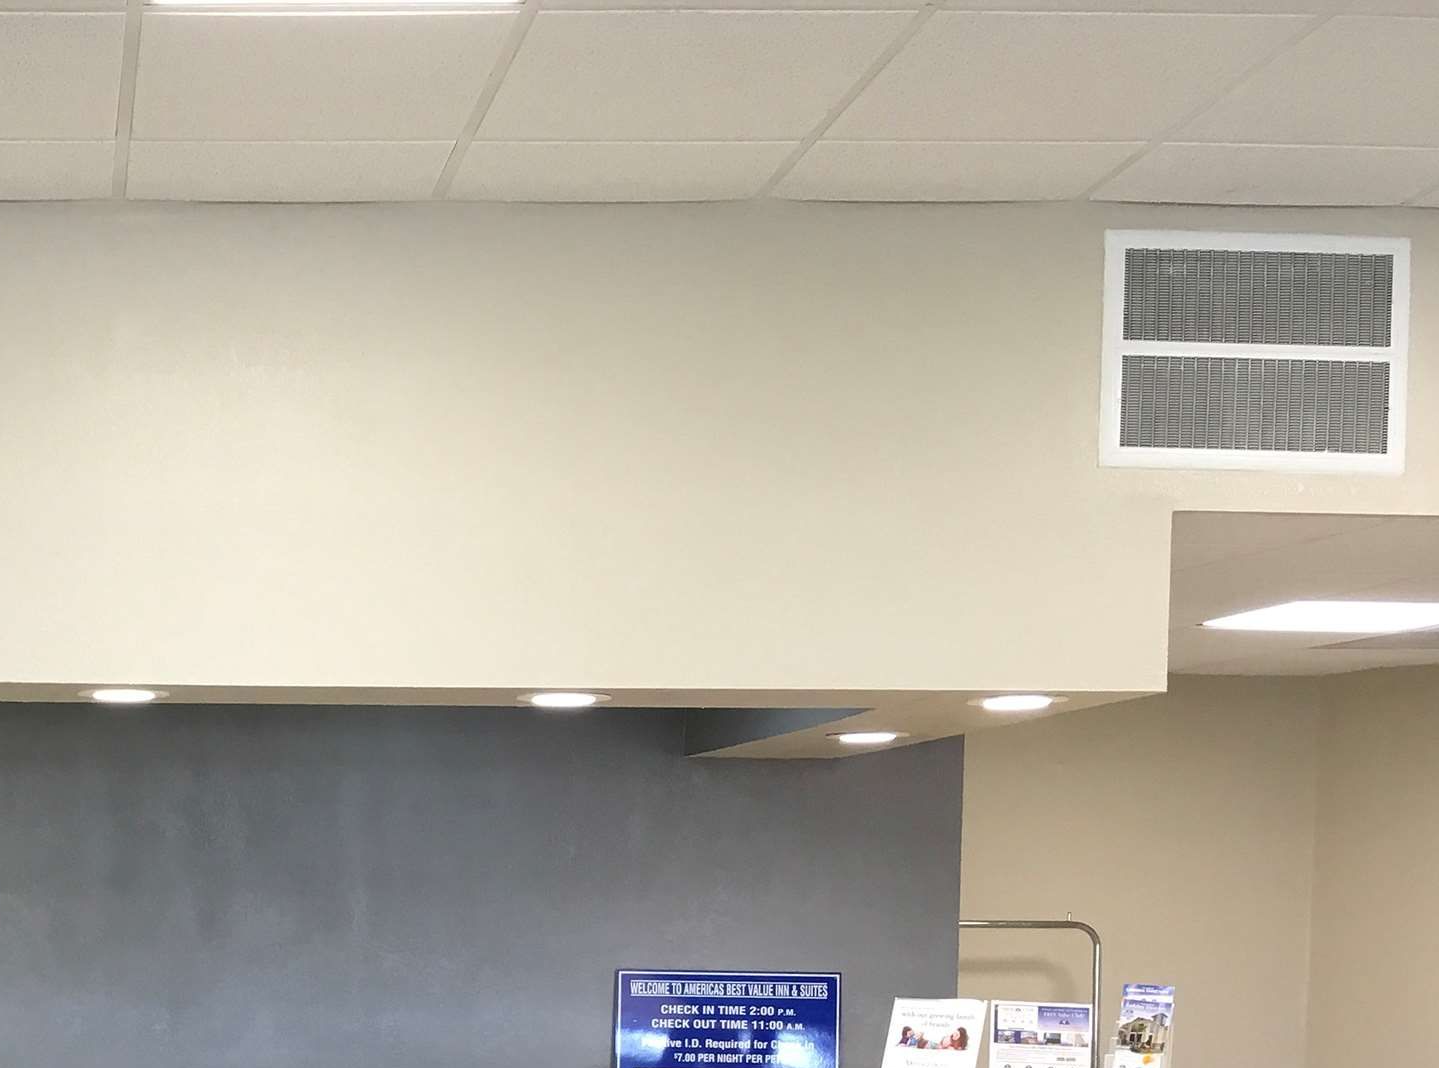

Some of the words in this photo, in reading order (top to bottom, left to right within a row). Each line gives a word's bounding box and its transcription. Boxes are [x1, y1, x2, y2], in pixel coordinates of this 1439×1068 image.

[630, 982, 670, 994] WELCOME
[672, 982, 682, 994] TO
[684, 983, 724, 995] AMERICAS
[726, 984, 746, 996] BEST
[748, 984, 773, 996] VALUE
[775, 984, 789, 996] INN
[791, 985, 798, 996] &
[800, 985, 828, 997] SUITES
[660, 1004, 700, 1015] CHECK
[702, 1005, 715, 1015] IN
[718, 1005, 746, 1015] TIME
[749, 1006, 775, 1016] 2:00
[777, 1008, 797, 1016] P.M.
[651, 1018, 690, 1028] CHECK
[693, 1019, 717, 1029] OUT
[719, 1019, 748, 1029] TIME
[751, 1020, 783, 1030] 11:00
[786, 1023, 806, 1031] A.M.
[685, 1038, 702, 1048] I.D.
[705, 1038, 751, 1050] Required
[753, 1039, 768, 1049] for
[698, 1053, 715, 1063] PER
[717, 1053, 744, 1063] NIGHT
[746, 1054, 763, 1064] PER
